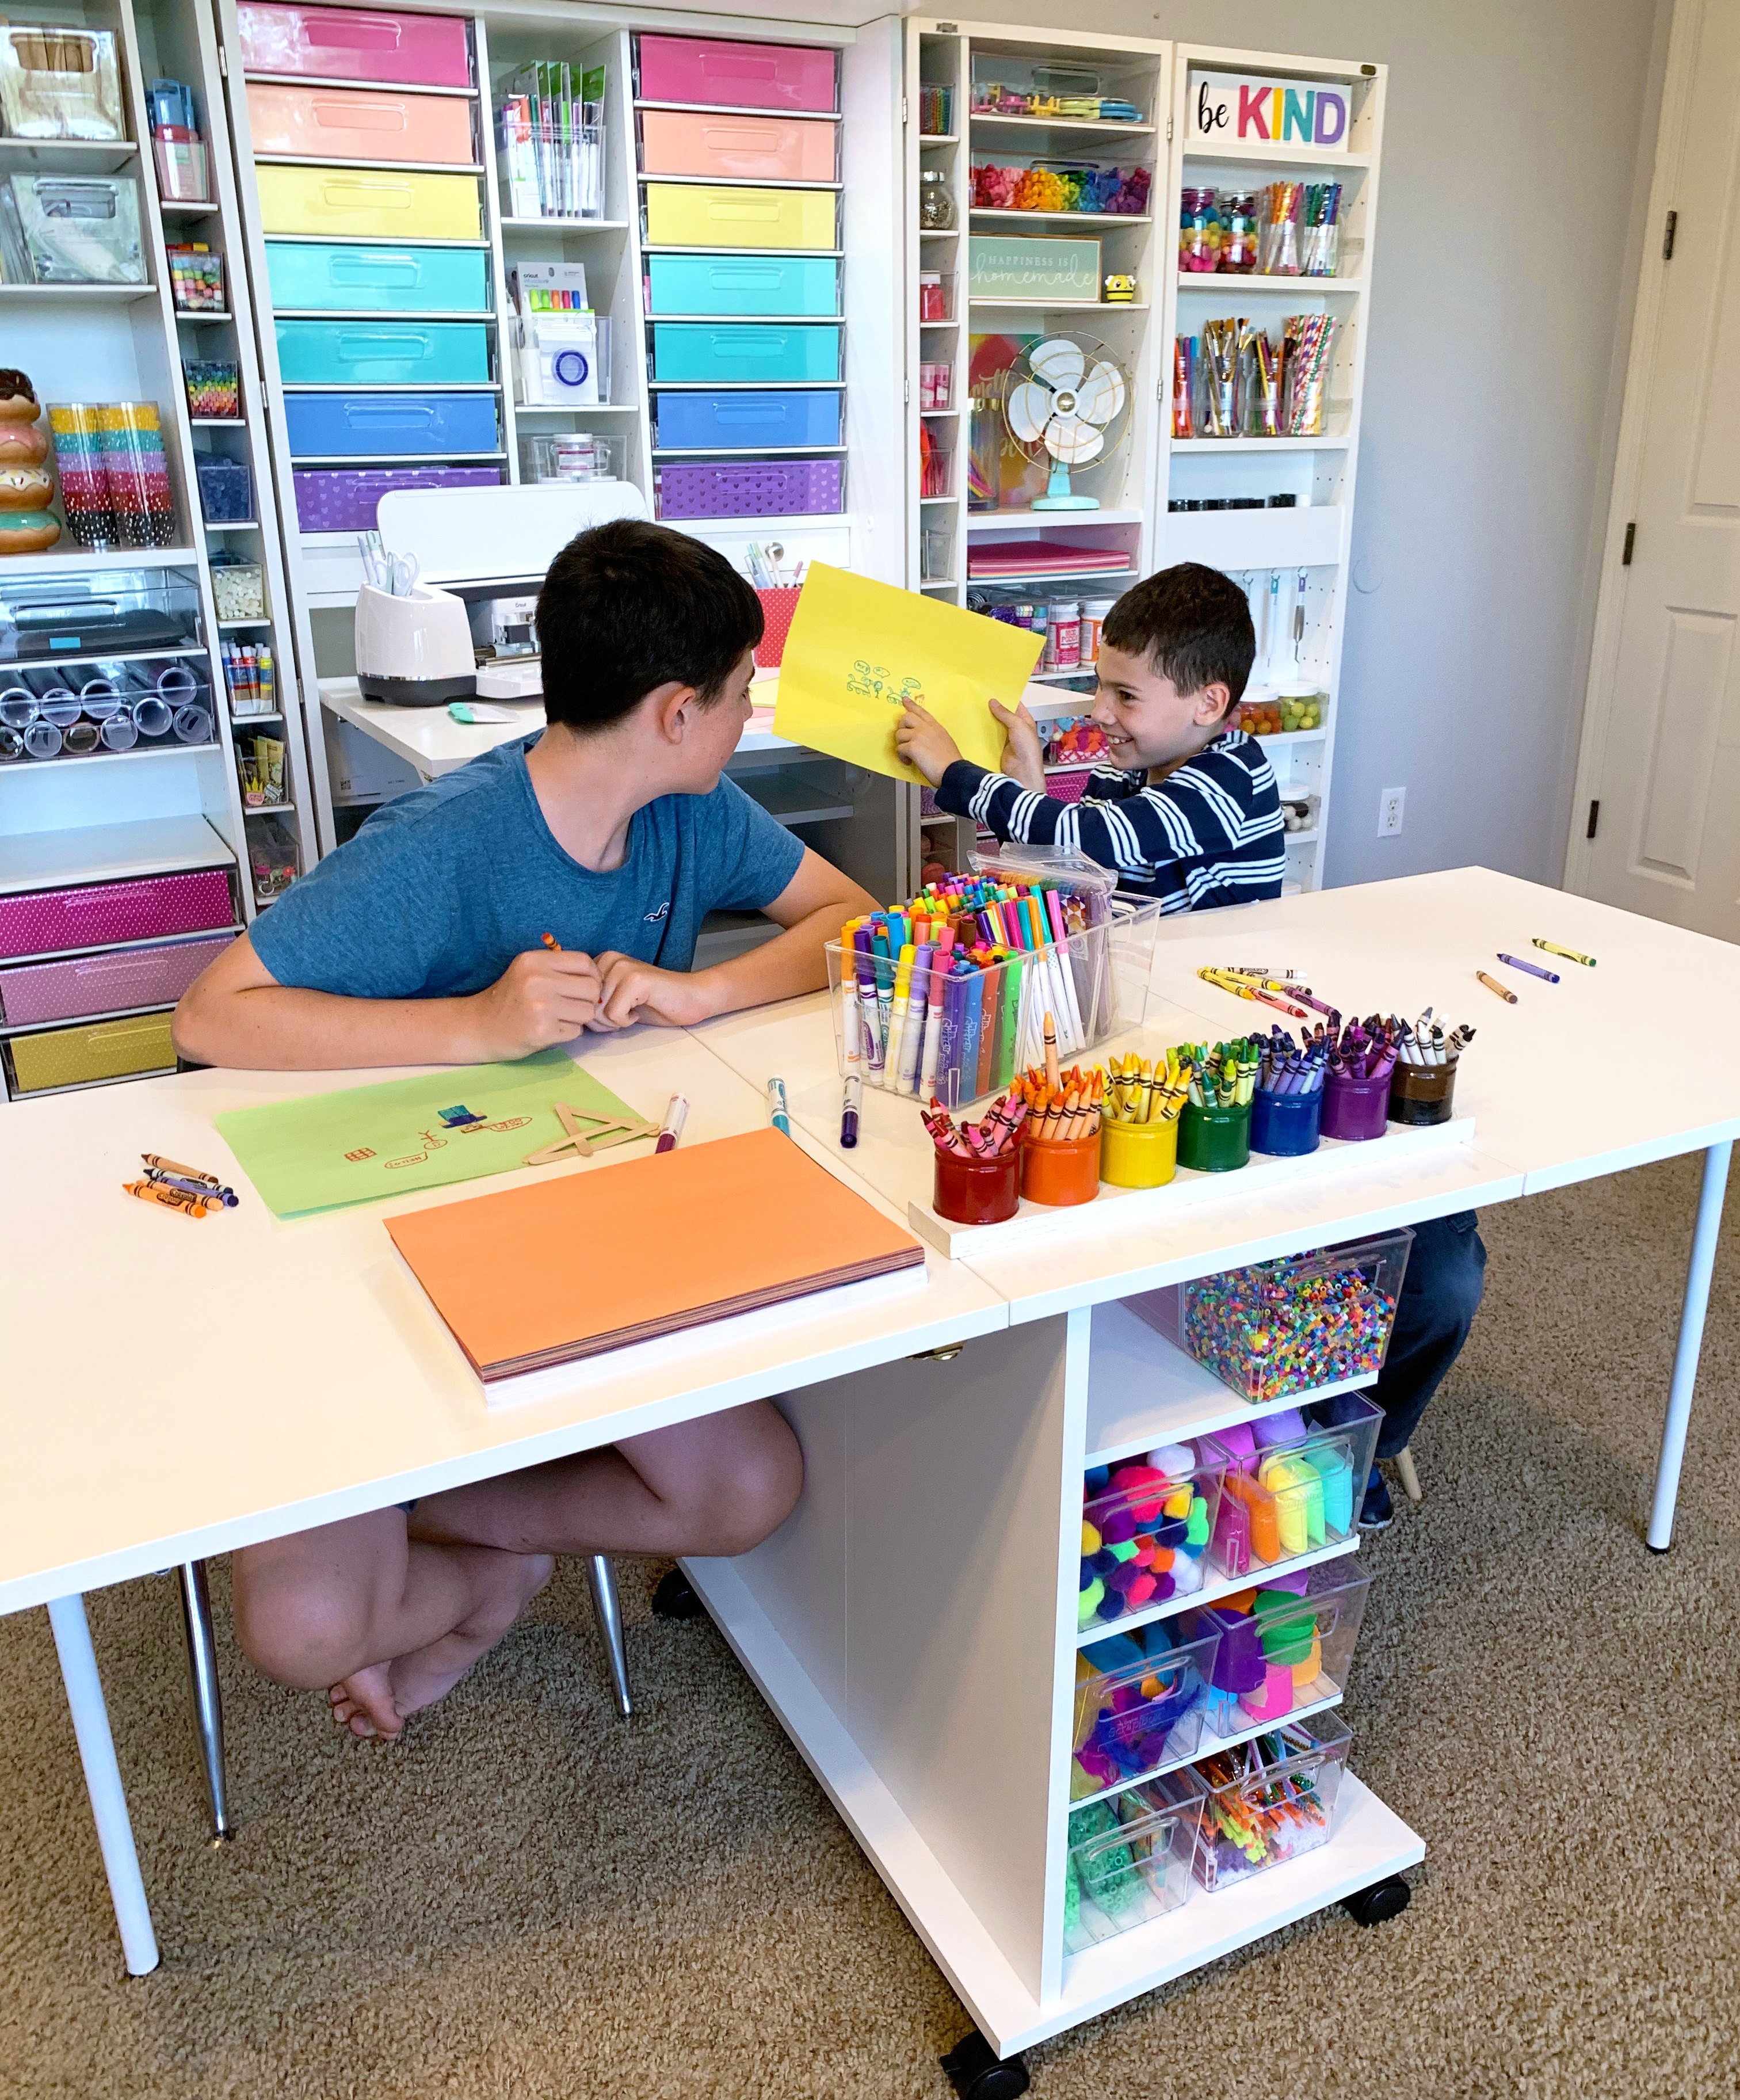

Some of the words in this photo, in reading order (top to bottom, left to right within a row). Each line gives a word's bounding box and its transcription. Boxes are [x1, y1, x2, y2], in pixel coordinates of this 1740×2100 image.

[1198, 81, 1230, 134] be
[1238, 85, 1346, 144] KIND
[970, 252, 1096, 288] homemade
[989, 256, 1054, 266] HAPPINESS
[1058, 258, 1069, 267] IS
